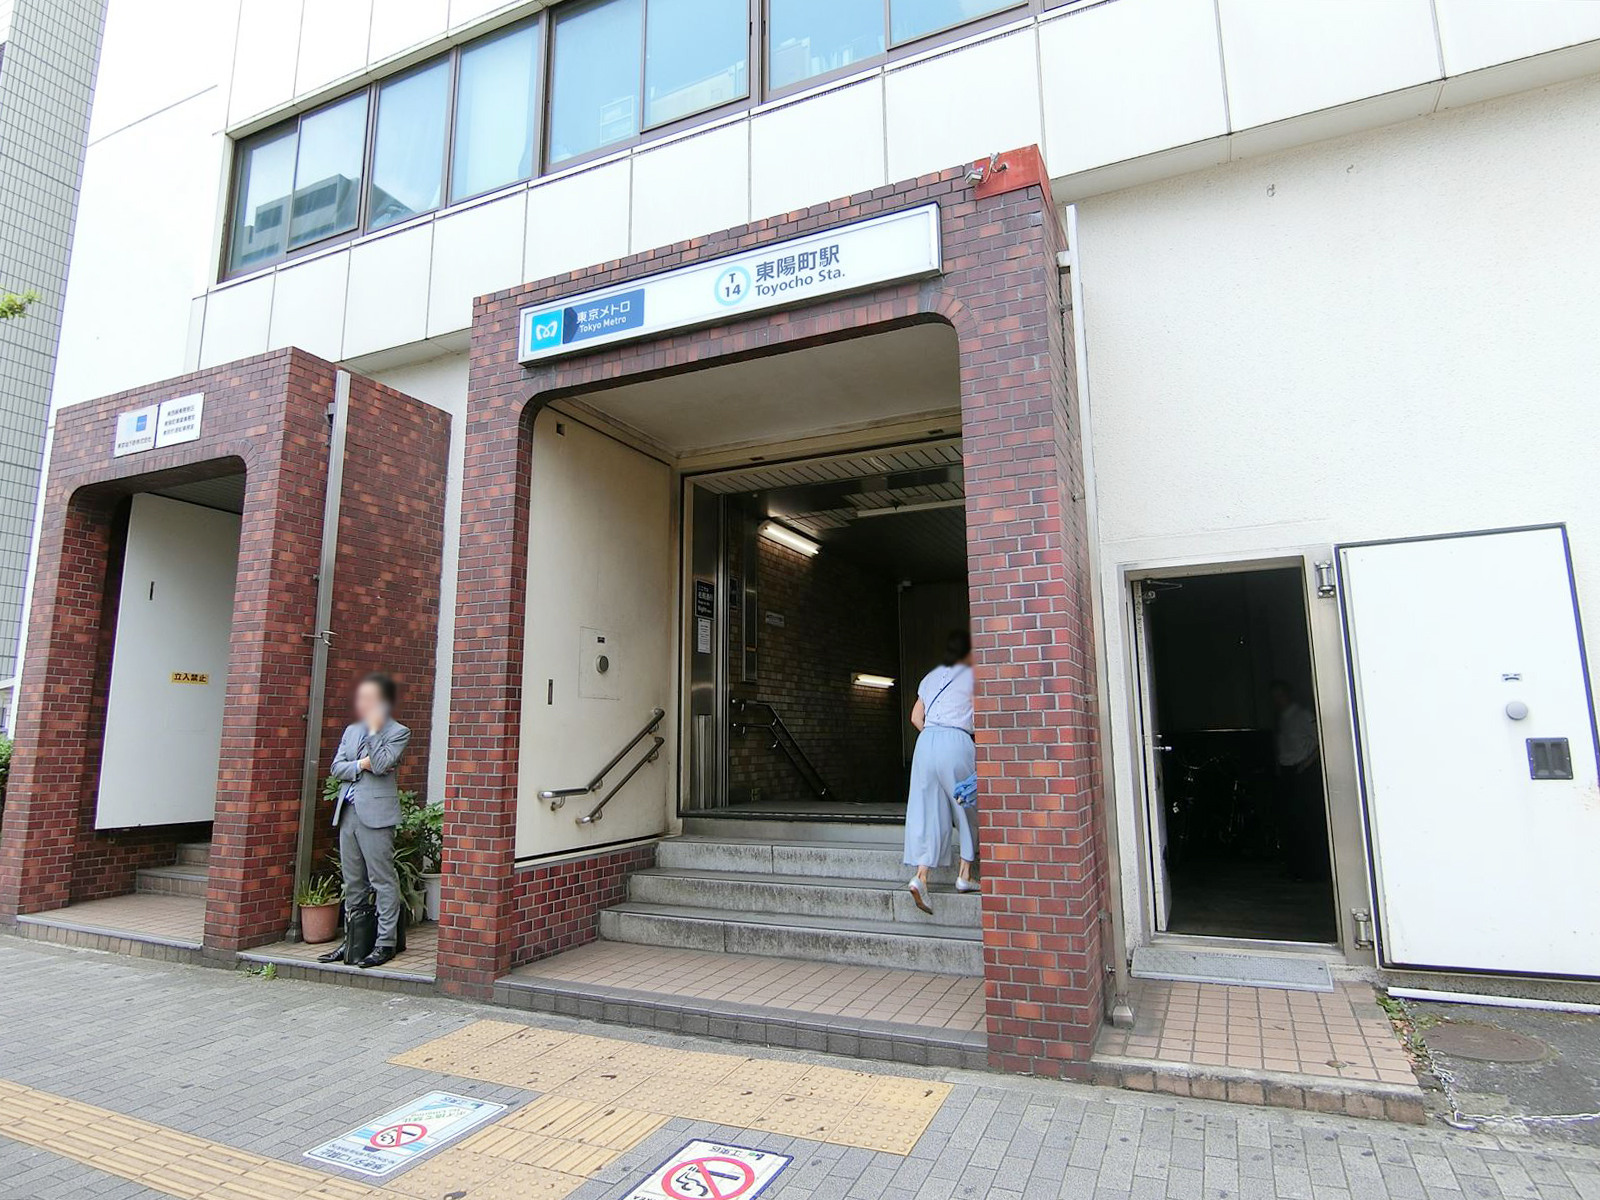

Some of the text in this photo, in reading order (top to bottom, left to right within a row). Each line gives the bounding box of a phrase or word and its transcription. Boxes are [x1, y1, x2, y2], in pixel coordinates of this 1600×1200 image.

[755, 245, 839, 282] 東陽町駅
[729, 273, 736, 283] T
[755, 269, 845, 296] Toyocho Sta.
[725, 285, 741, 297] 14
[576, 301, 630, 324] 東京メトロ
[579, 316, 627, 333] Tokyo Metro
[174, 673, 206, 682] 立入禁止
